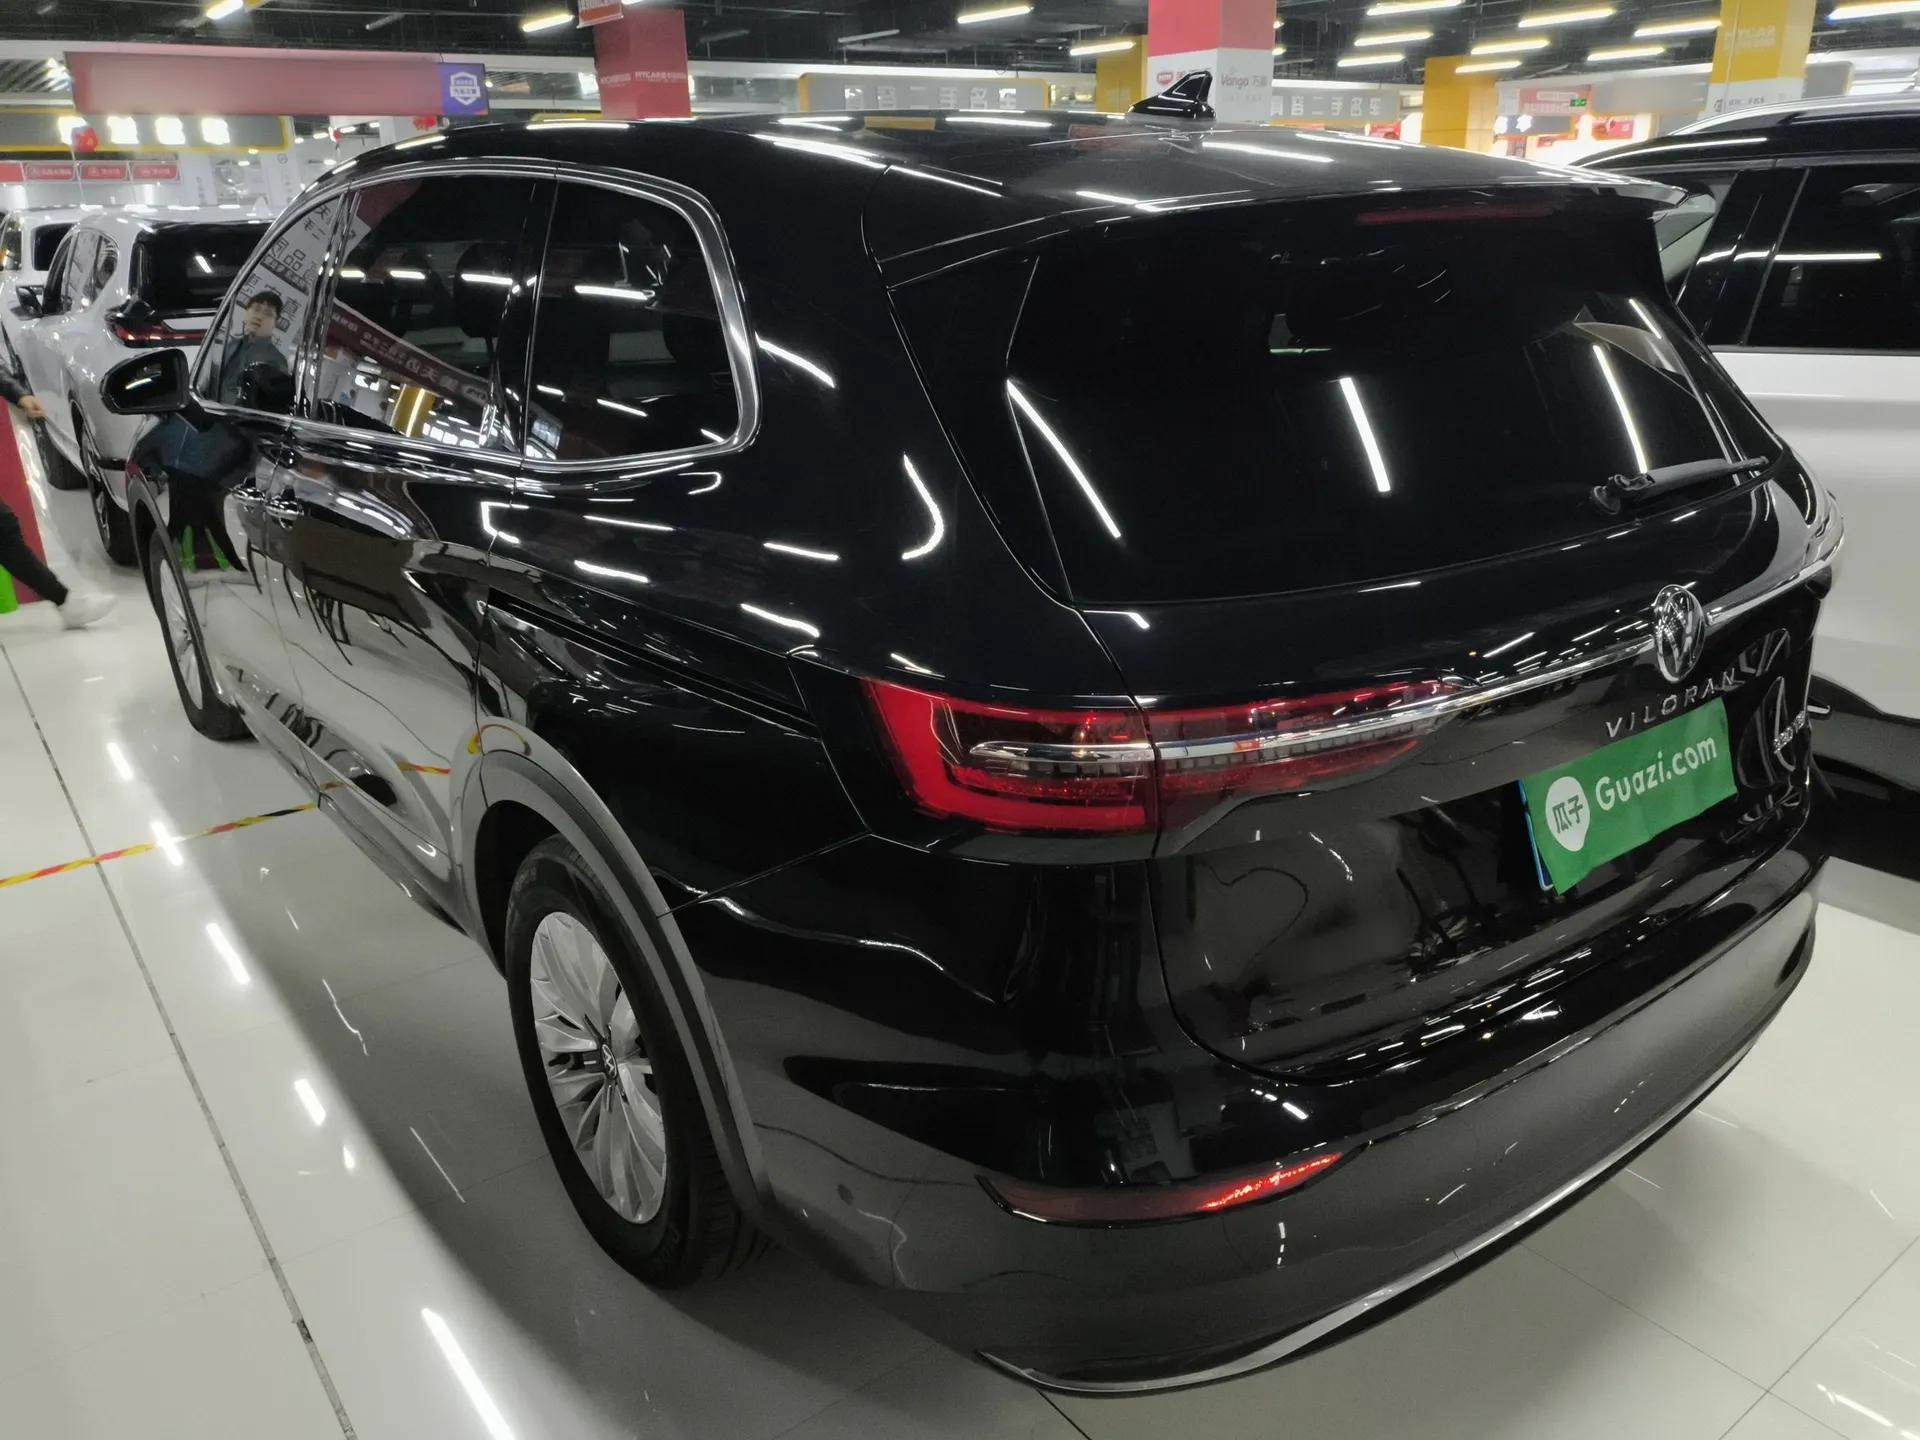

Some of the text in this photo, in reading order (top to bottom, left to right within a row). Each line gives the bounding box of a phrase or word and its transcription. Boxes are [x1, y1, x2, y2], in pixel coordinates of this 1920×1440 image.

[1606, 668, 1735, 738] VILORAN
[1552, 737, 1718, 834] 瓜子 Guazi.com
